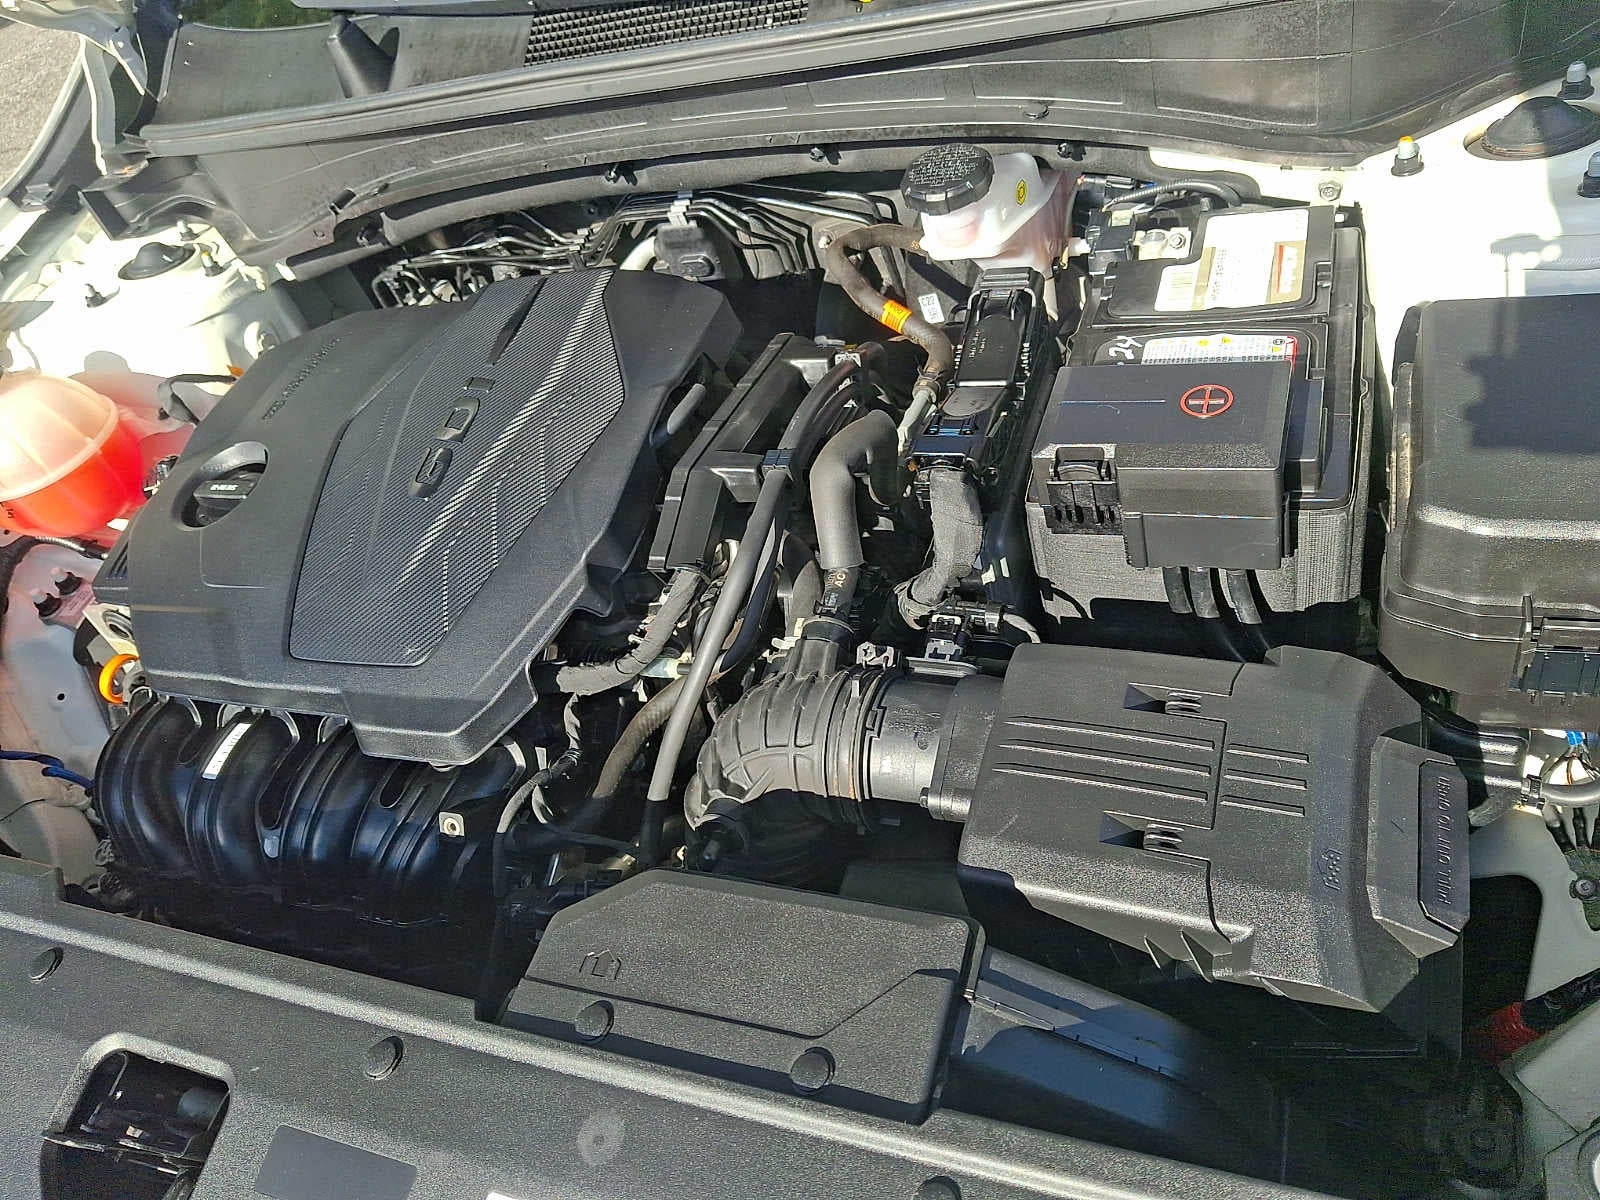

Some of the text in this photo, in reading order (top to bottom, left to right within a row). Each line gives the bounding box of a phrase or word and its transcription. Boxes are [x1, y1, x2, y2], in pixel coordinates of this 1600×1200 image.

[407, 376, 496, 500] GDI
[1437, 776, 1452, 904] PULL OUT TO OPEN
